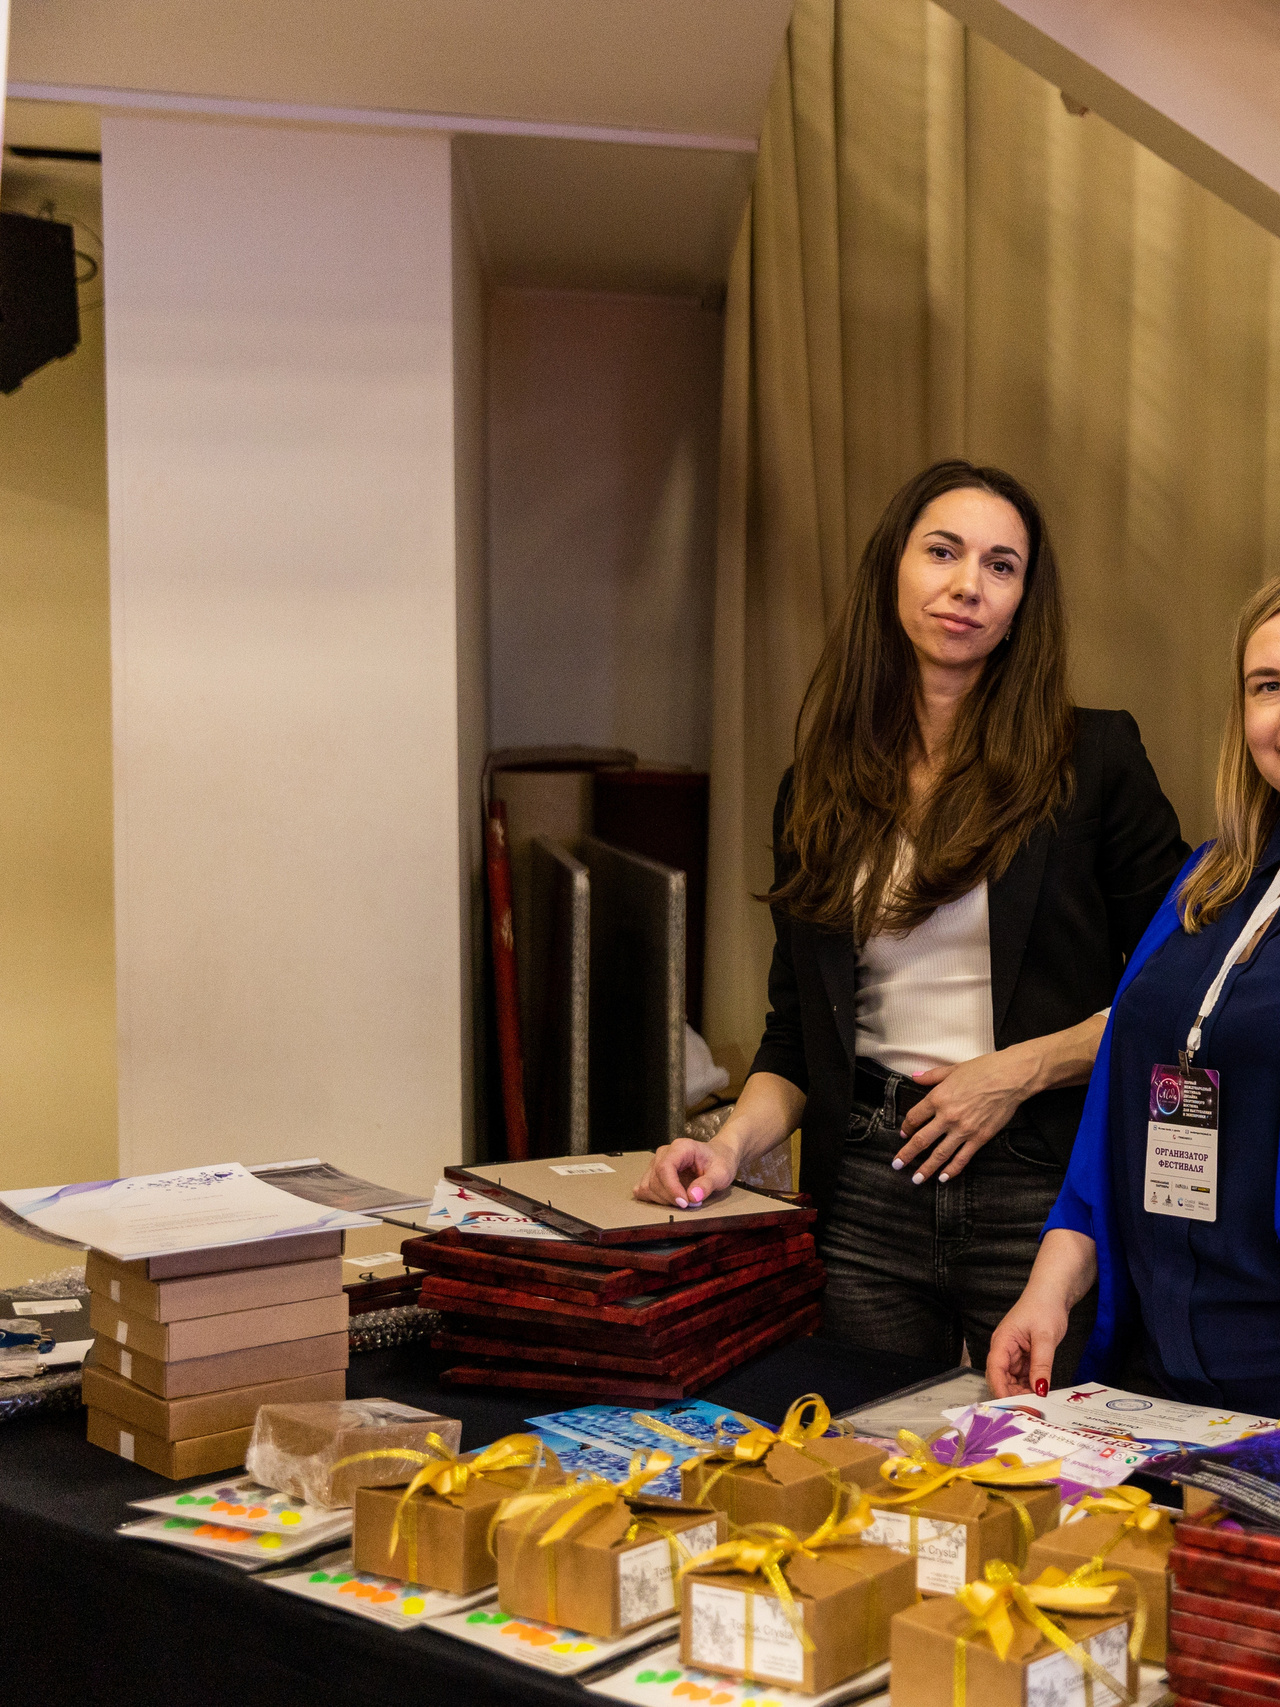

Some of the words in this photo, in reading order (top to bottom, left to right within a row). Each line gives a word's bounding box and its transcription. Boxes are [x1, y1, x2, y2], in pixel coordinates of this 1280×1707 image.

[1155, 1147, 1209, 1162] ОРГАНИЗАТОР
[1158, 1160, 1204, 1173] ФЕСТИВАЛЯ
[928, 1544, 959, 1559] Crystal
[763, 1624, 794, 1640] Crysta
